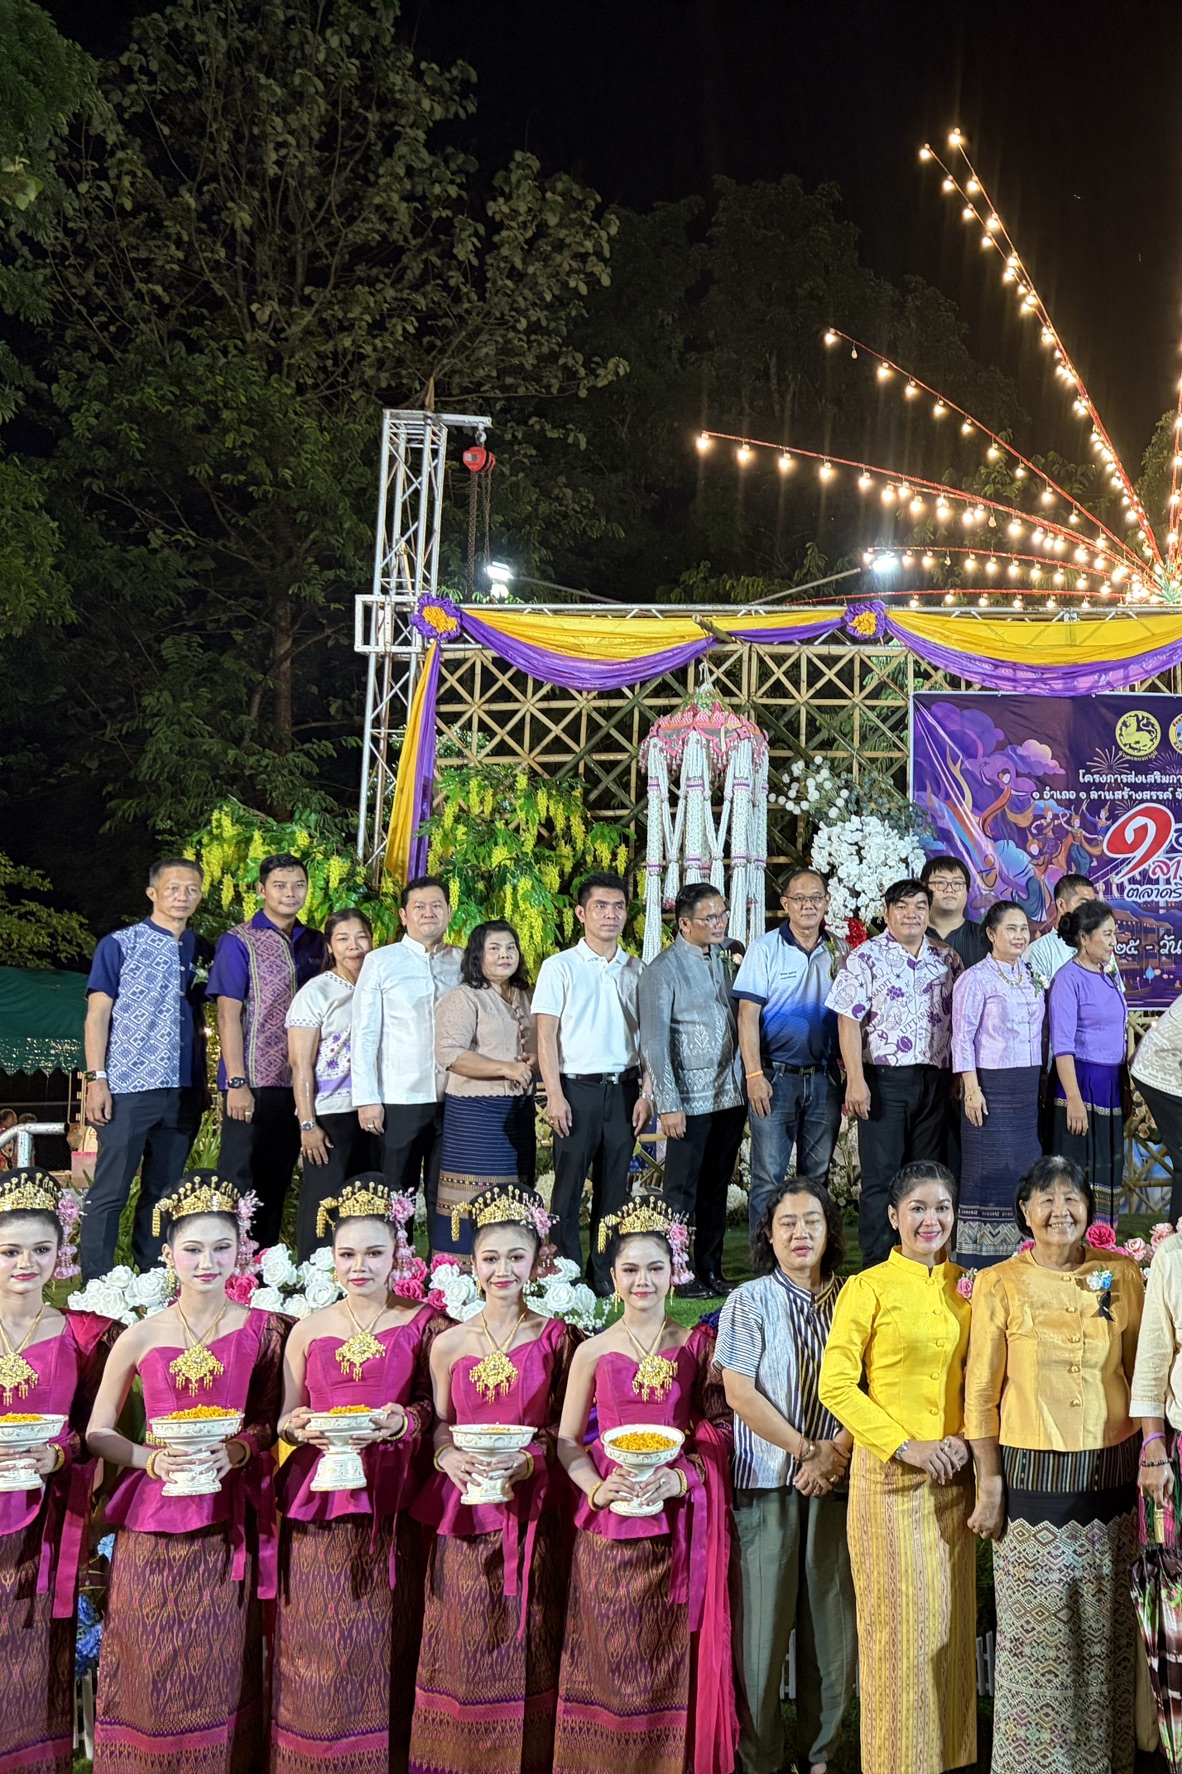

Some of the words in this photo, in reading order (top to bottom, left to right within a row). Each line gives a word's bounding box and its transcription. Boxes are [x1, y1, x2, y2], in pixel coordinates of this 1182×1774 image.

[1032, 791, 1040, 799] ๑
[1043, 787, 1076, 799] อำเภอ
[1090, 788, 1173, 800] ลานสร้างสรรค์
[900, 1000, 943, 1034] UTTARADIT
